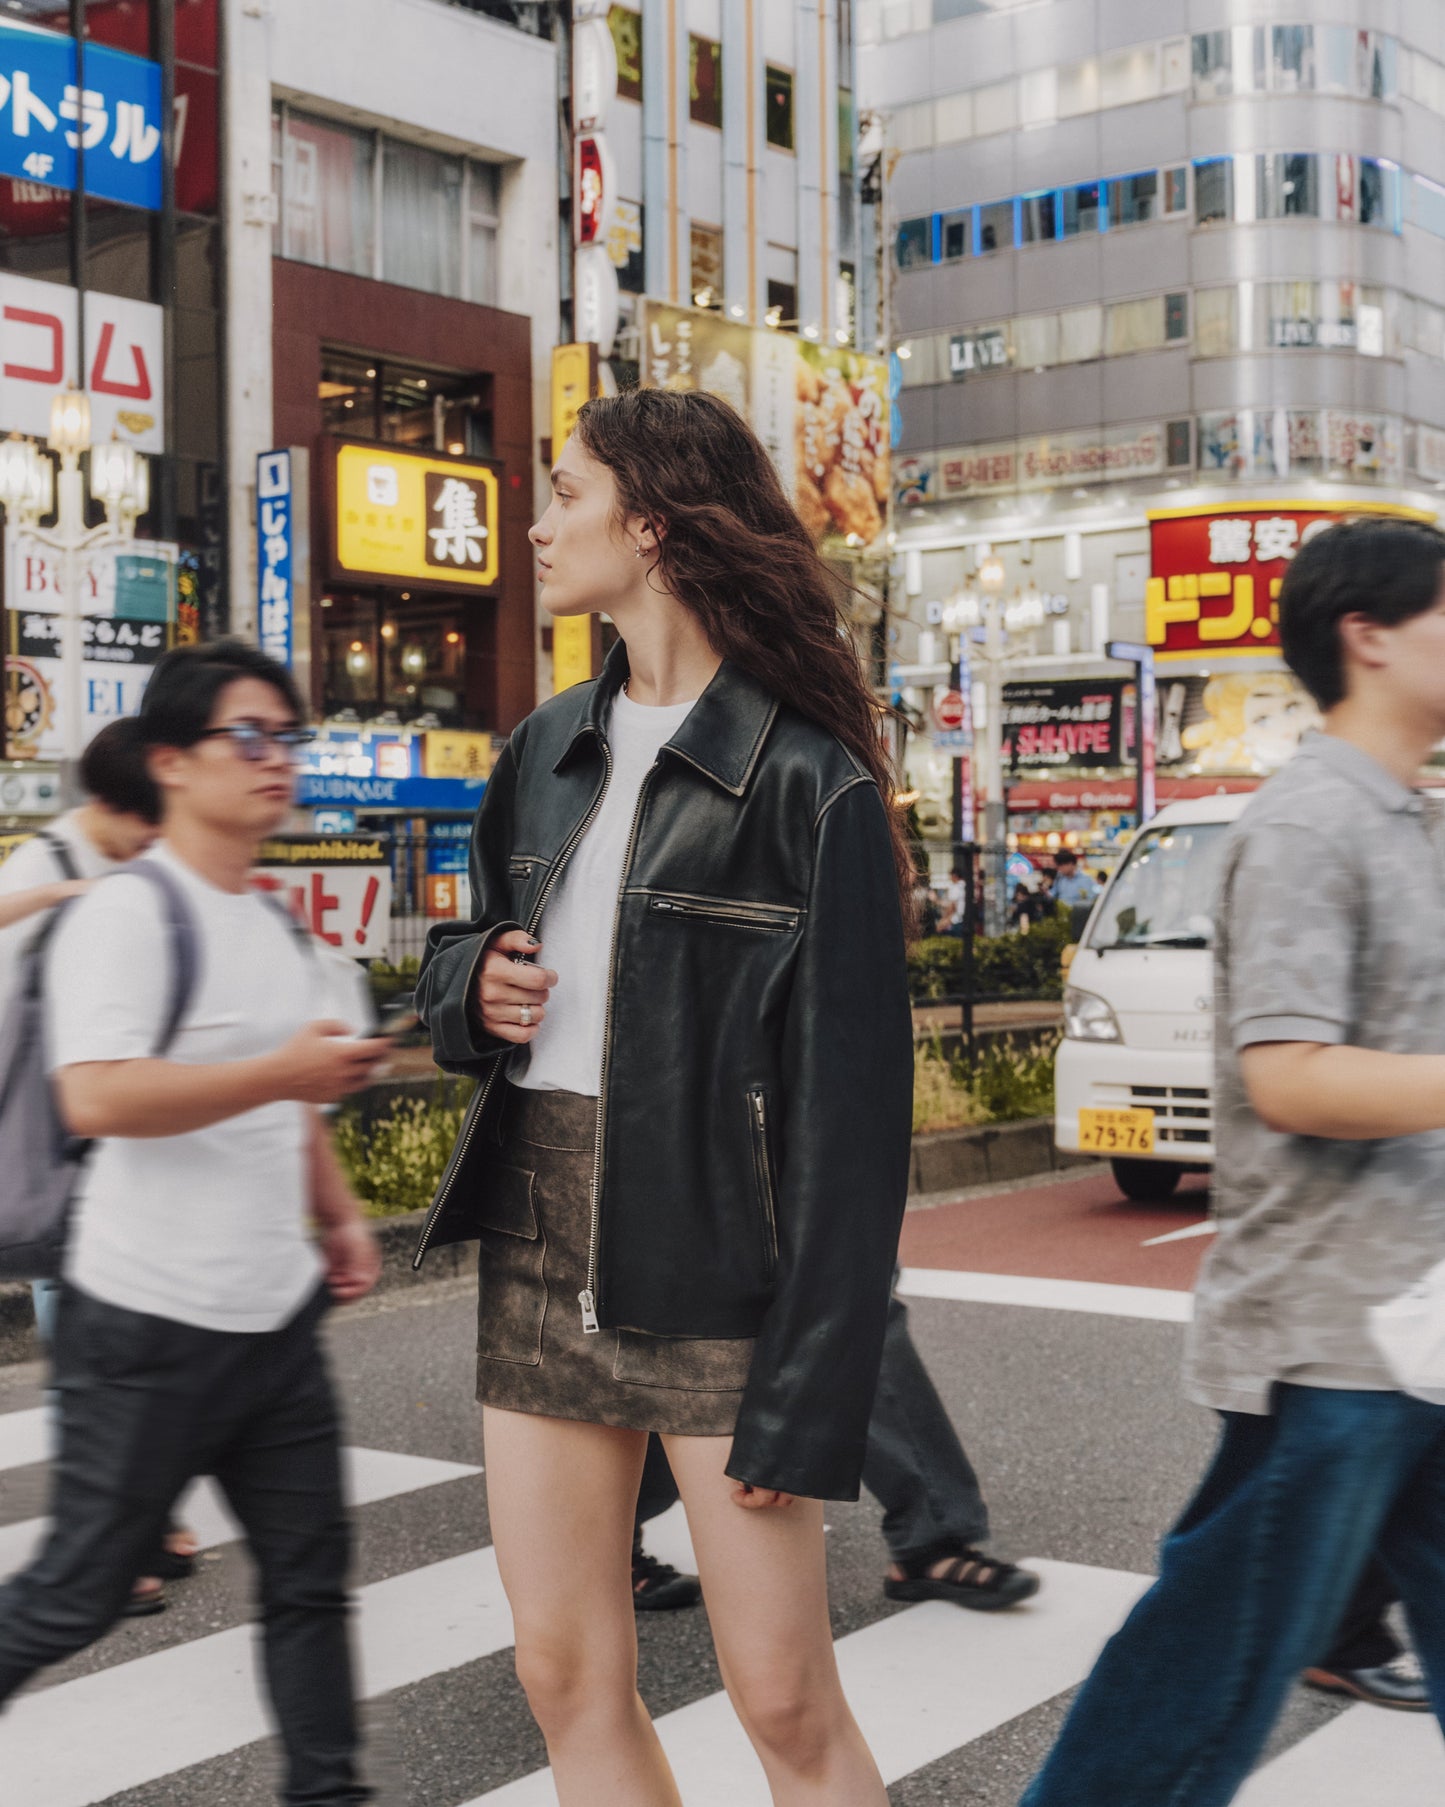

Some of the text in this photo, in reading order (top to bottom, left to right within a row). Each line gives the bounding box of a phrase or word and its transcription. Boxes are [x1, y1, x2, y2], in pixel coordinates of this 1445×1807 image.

[22, 152, 55, 179] 4F
[427, 478, 489, 565] 集
[1095, 1126, 1148, 1149] 79-76
